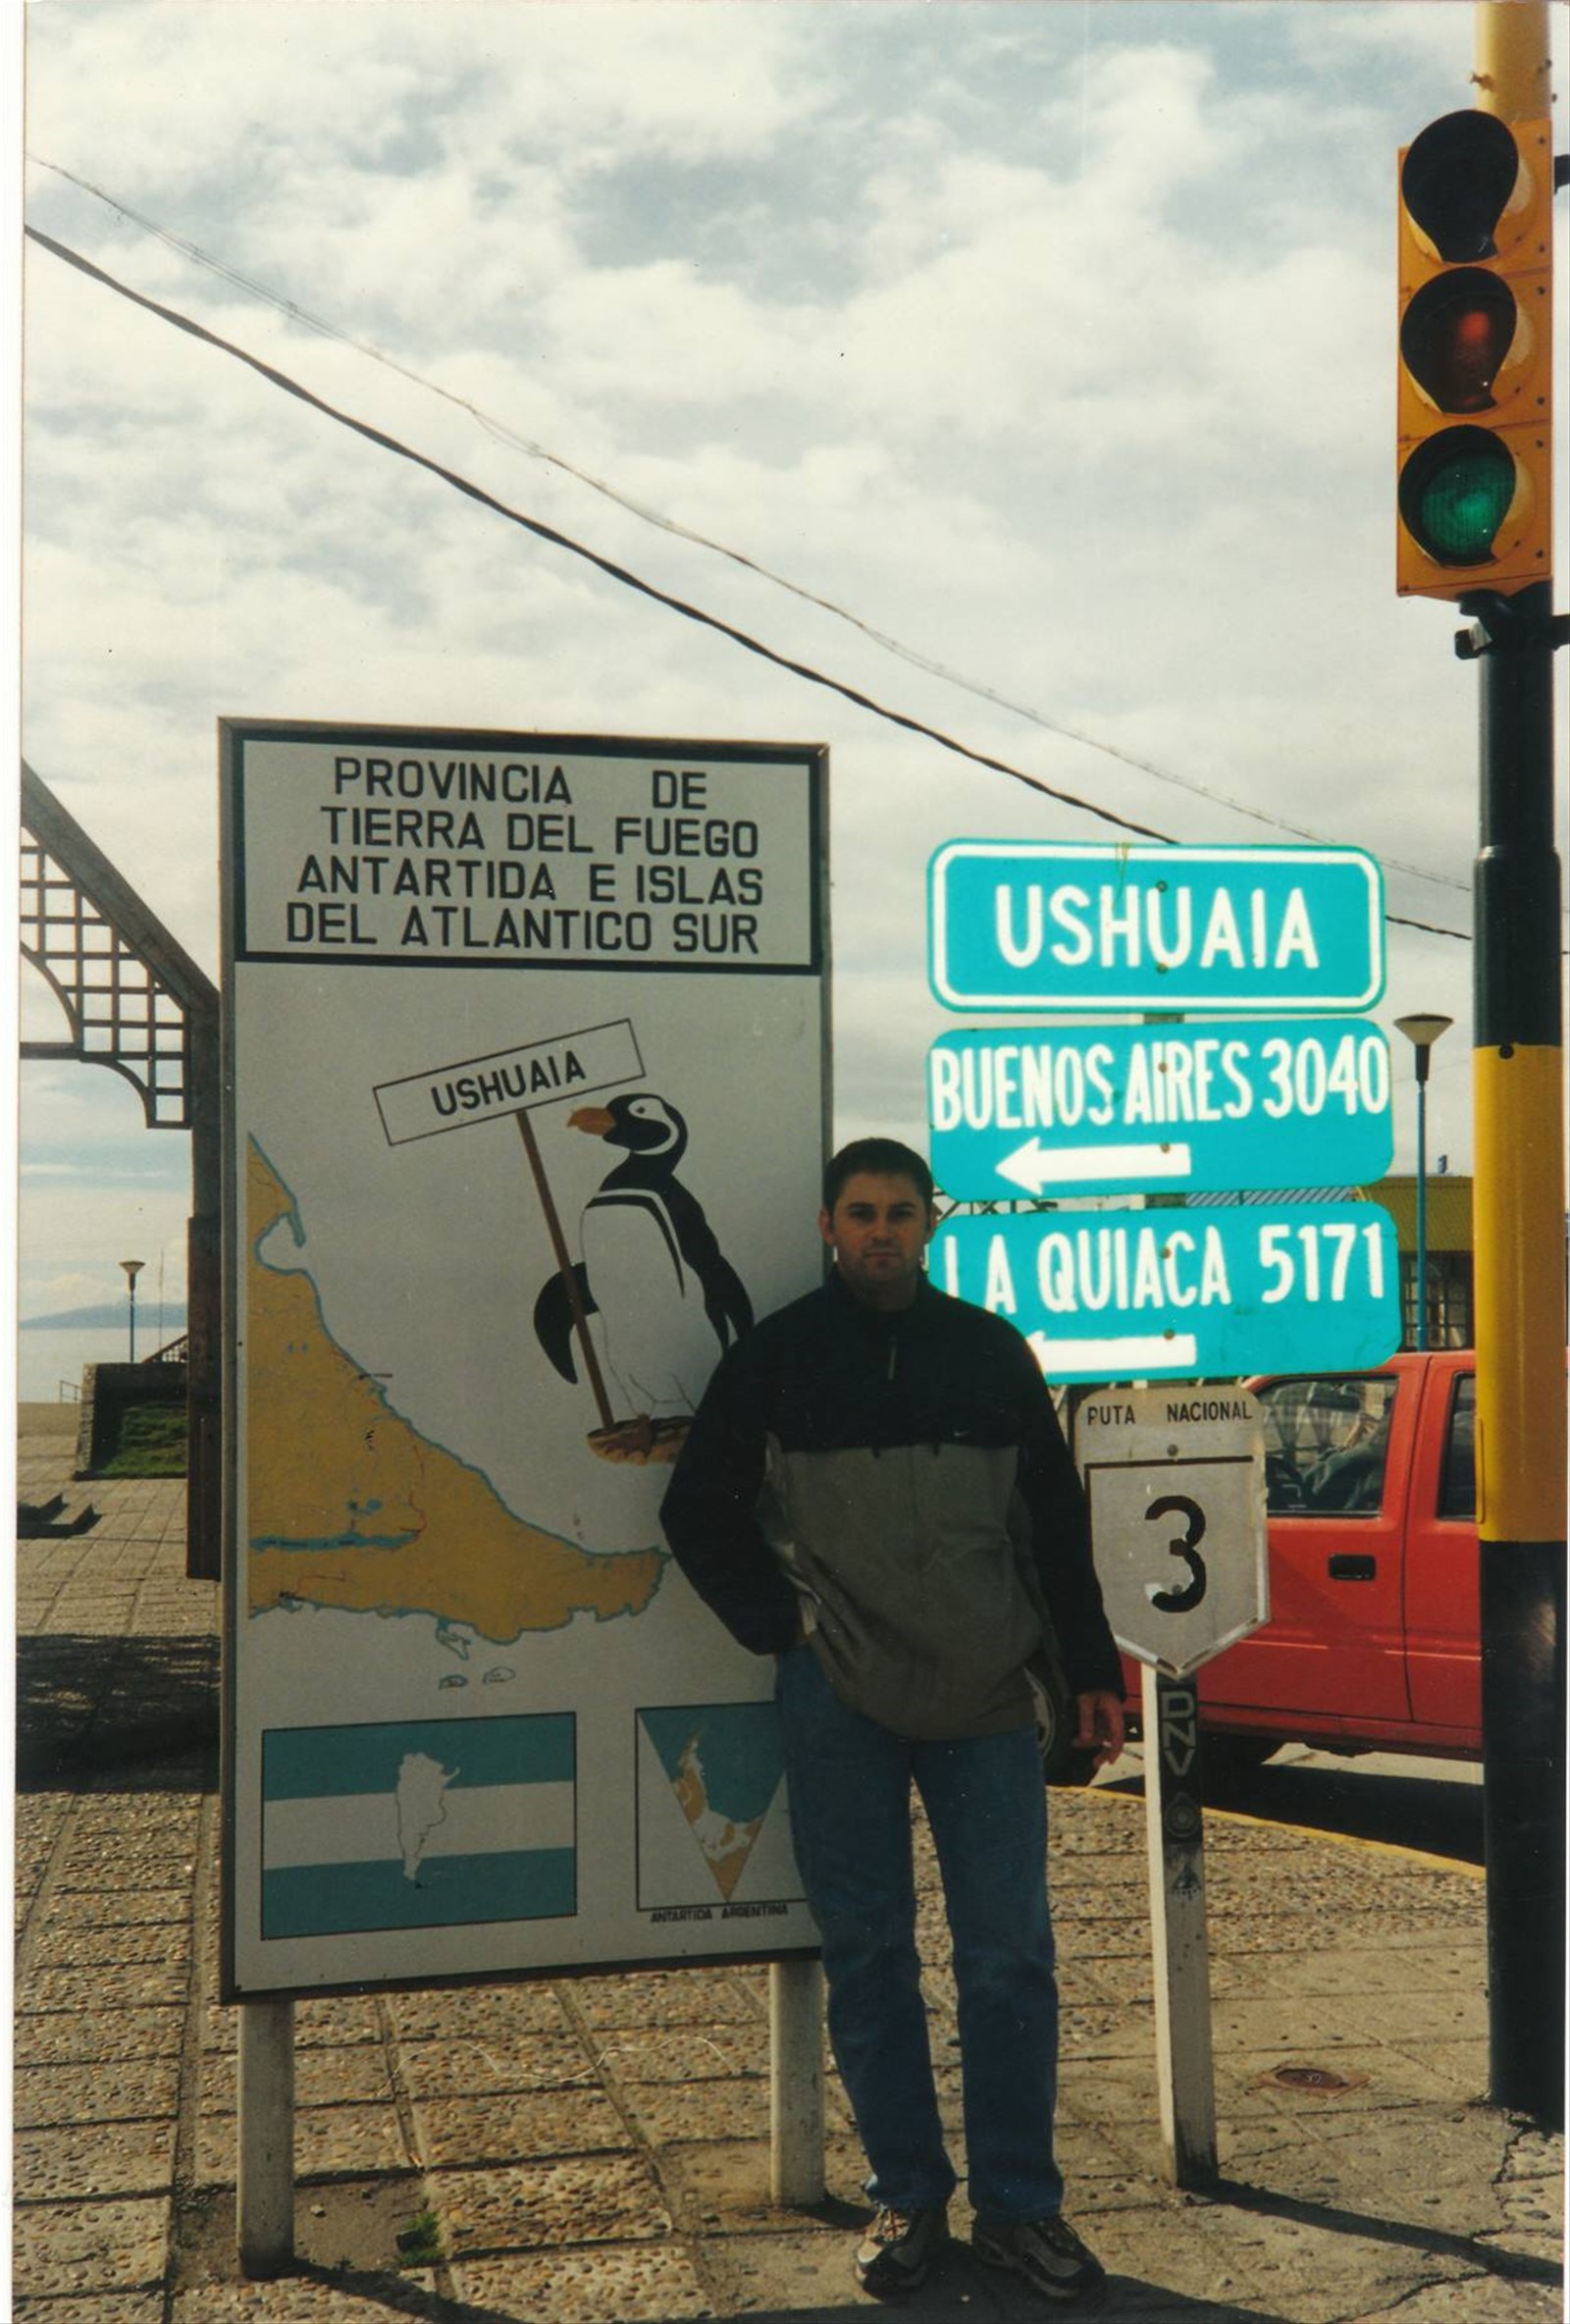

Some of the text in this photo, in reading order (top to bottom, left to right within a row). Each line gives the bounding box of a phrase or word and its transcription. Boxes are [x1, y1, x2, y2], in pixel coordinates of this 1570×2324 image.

[335, 757, 707, 810] PROVINCIA DE
[320, 806, 759, 858] TIERRA DEL FUEGO
[297, 855, 763, 906] ANTARTIDA E ISLAS
[287, 902, 759, 954] DEL ATLANTICO SUR
[995, 884, 1320, 969] USHUAIA
[431, 1050, 587, 1116] USHUAIA
[930, 1034, 1390, 1132] BUENOS AIRES 3040
[1037, 1225, 1232, 1313] QUIACA
[1258, 1222, 1385, 1304] 5171
[1167, 1400, 1253, 1423] NACIONAL
[1145, 1495, 1207, 1613] 3
